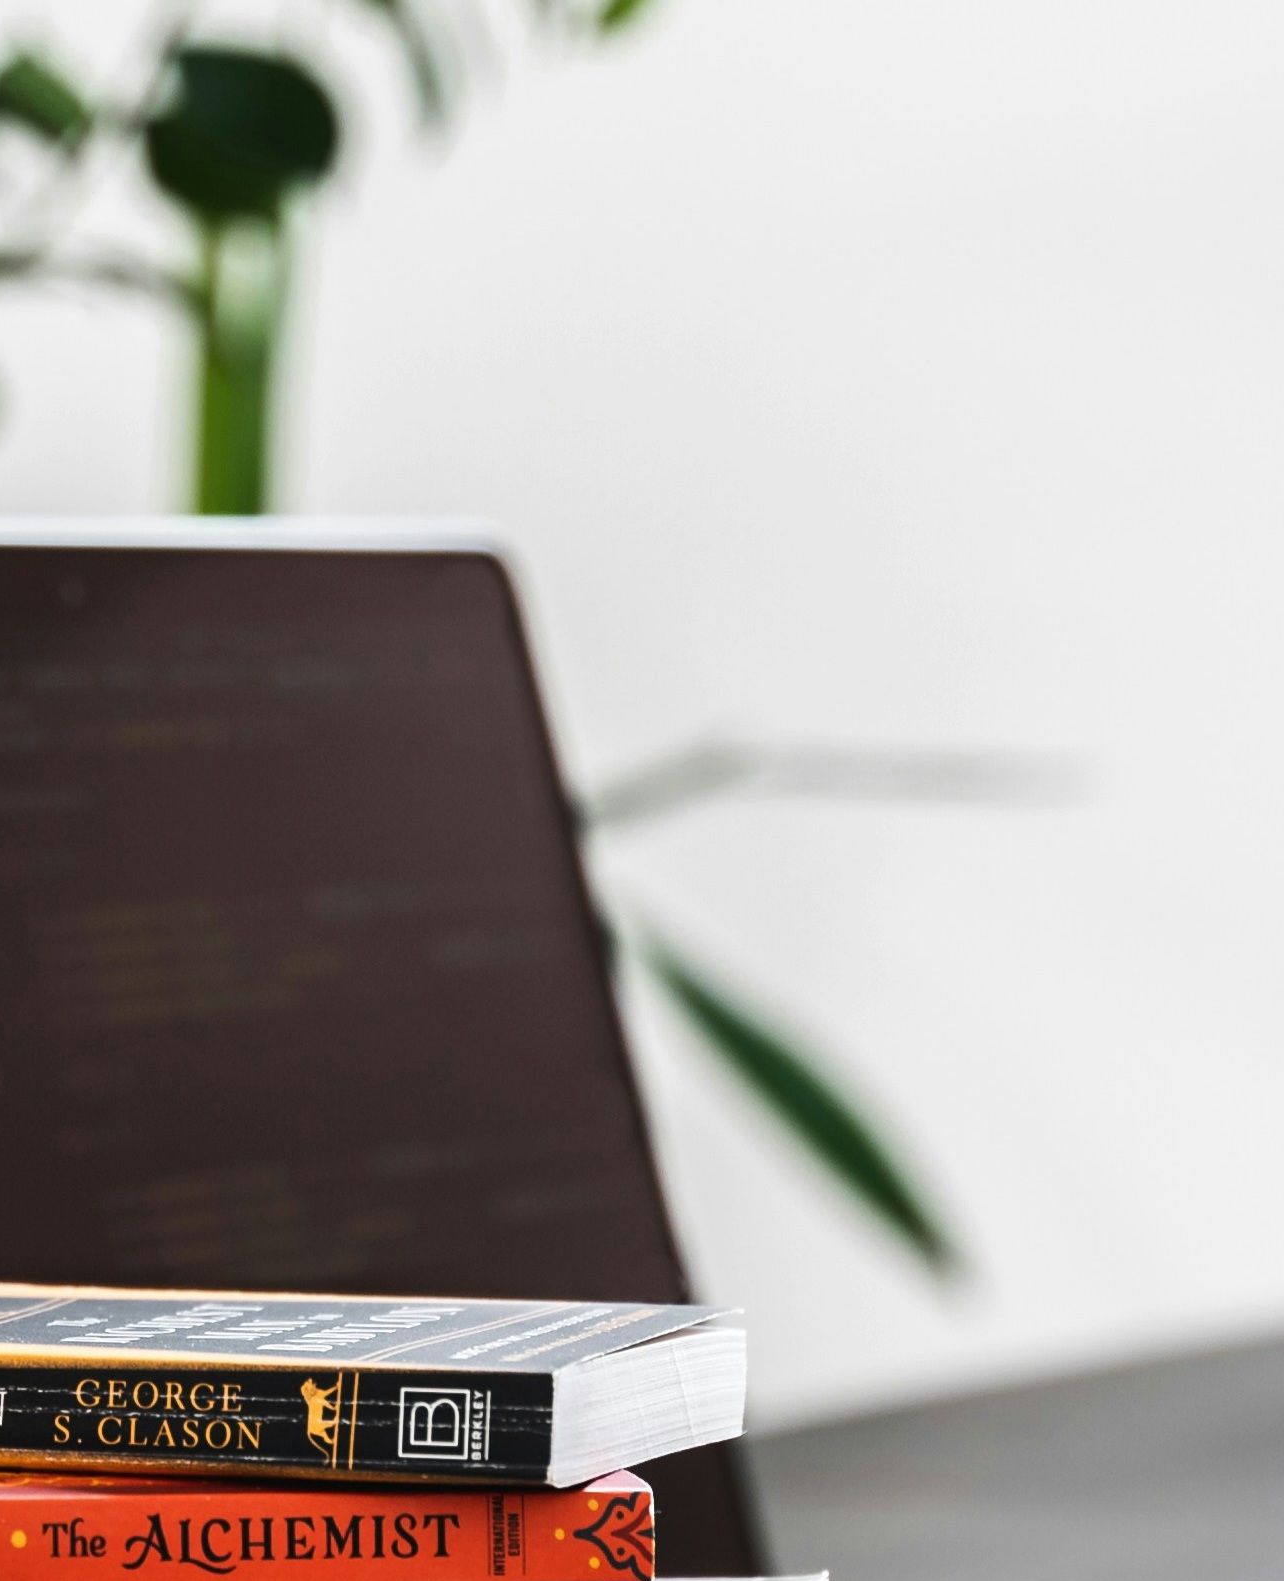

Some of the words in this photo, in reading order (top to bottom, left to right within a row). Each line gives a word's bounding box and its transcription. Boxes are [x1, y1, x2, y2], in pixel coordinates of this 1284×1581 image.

[76, 1378, 243, 1412] GEORGE
[53, 1416, 85, 1446] S.
[97, 1416, 262, 1450] CLASON
[470, 1390, 484, 1461] BERKLEY
[43, 1517, 107, 1560] The
[122, 1512, 460, 1574] ALCHEMIST
[492, 1493, 506, 1576] INTERNATIONAL
[507, 1512, 520, 1557] EDITION
